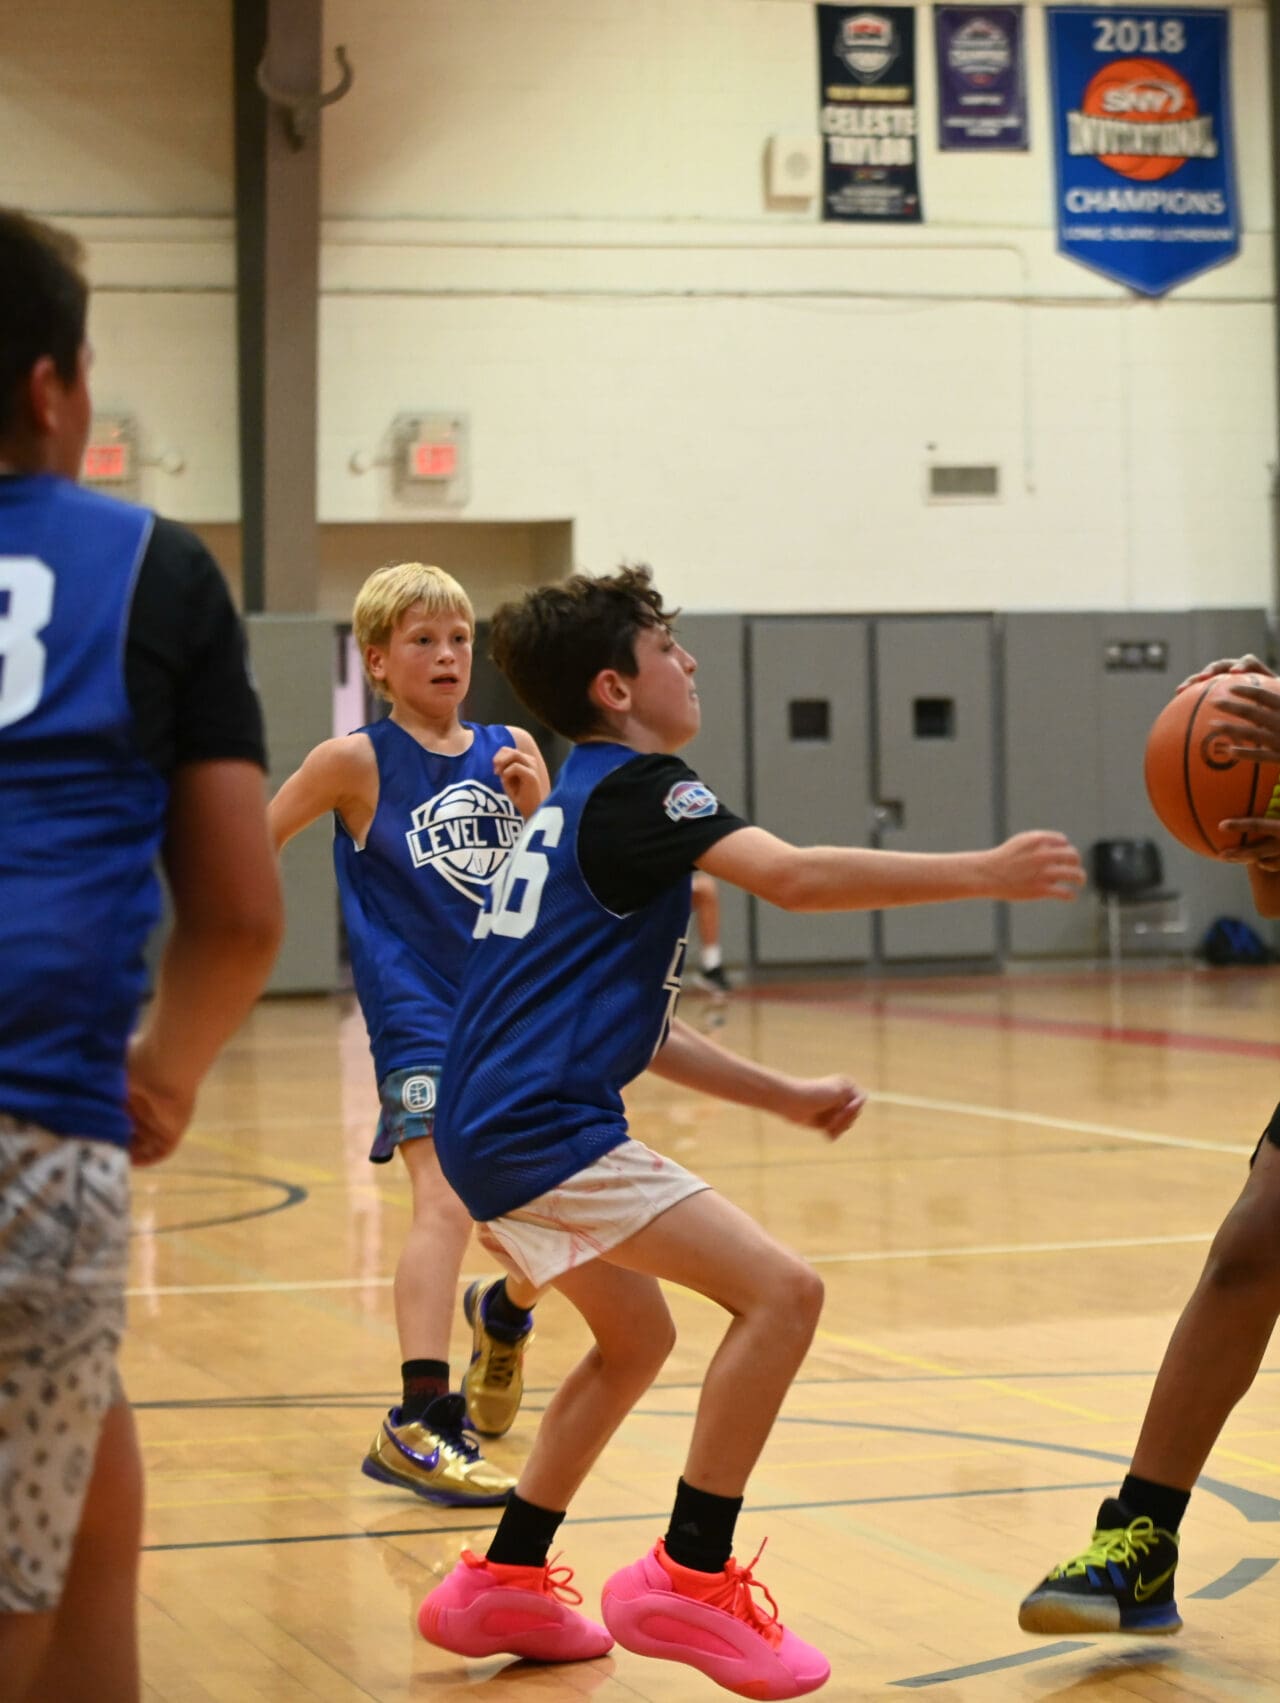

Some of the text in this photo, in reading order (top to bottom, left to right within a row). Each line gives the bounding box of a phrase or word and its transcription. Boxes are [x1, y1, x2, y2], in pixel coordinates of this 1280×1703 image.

[1092, 18, 1187, 53] 2018
[1066, 187, 1226, 215] CHAMPIONS
[412, 818, 487, 862] LEVEL
